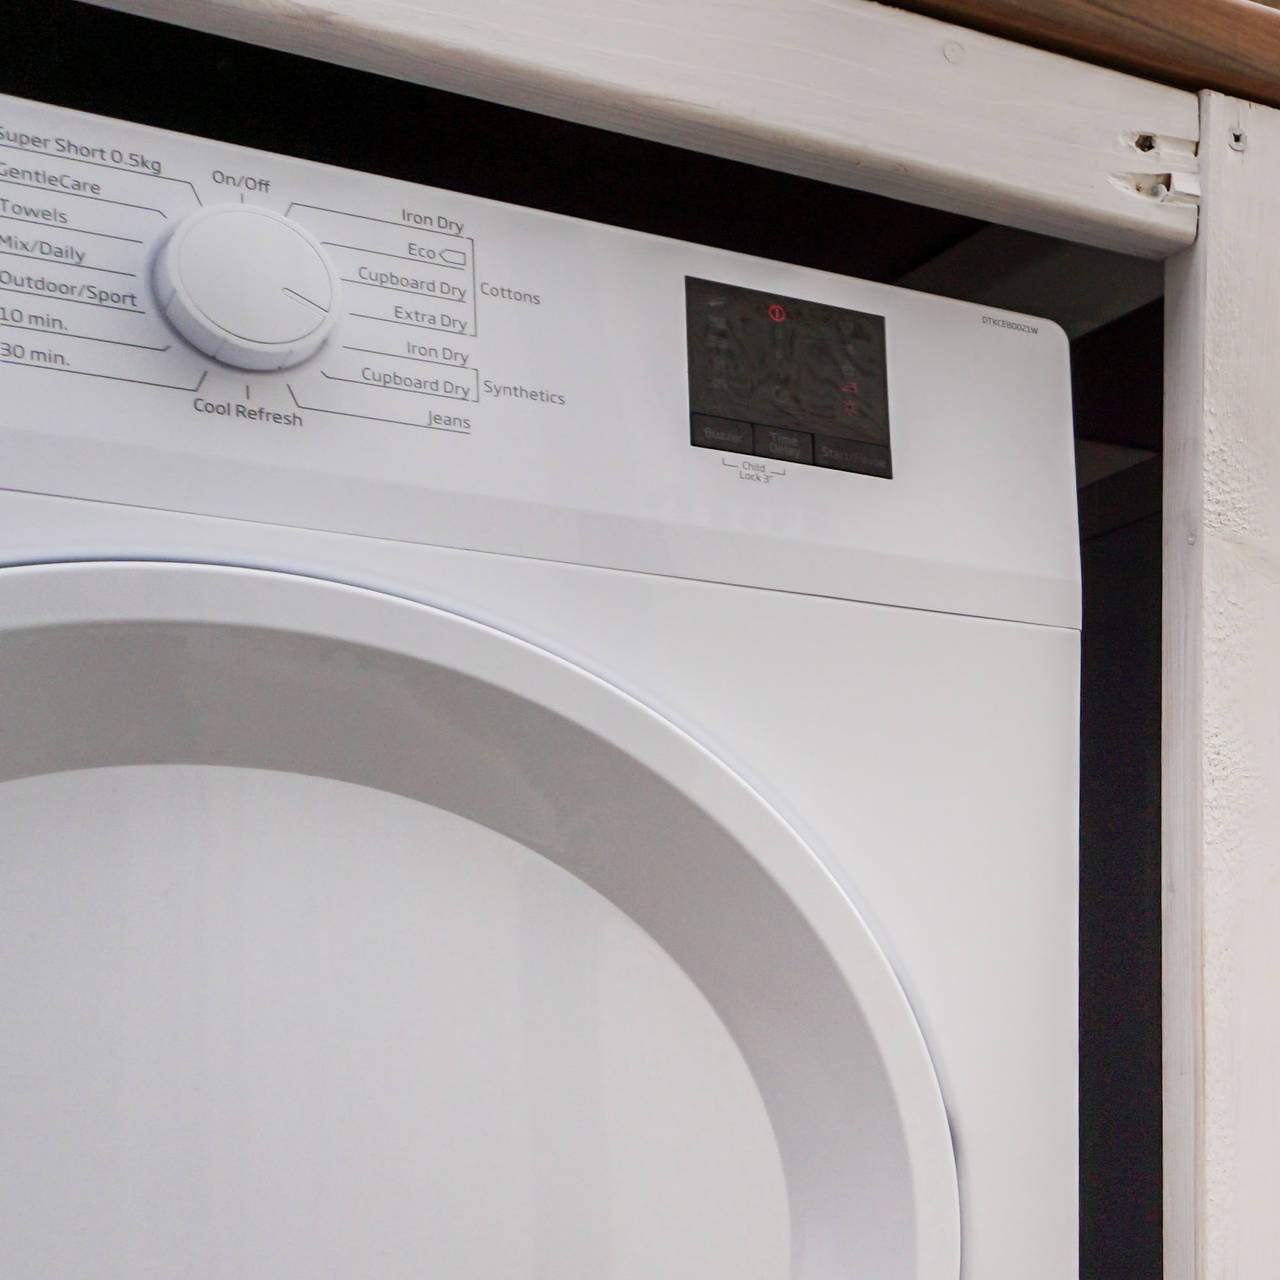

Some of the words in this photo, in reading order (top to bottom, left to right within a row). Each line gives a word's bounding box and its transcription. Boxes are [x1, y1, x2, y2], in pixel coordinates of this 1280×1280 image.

[0, 126, 50, 149] Super
[55, 138, 107, 161] Short
[110, 149, 162, 175] 0.5kg
[212, 170, 271, 193] On/Off
[0, 198, 68, 223] Towels
[402, 208, 433, 227] Iron
[437, 215, 464, 236] Dry
[0, 233, 86, 264] Mix/Daily
[408, 242, 436, 259] Eco
[0, 270, 138, 307] Outdoor/Sport
[358, 266, 436, 292] Cupboard
[440, 281, 467, 302] Dry
[480, 282, 542, 305] Cottons
[0, 306, 23, 323] 10
[28, 310, 68, 331] min.
[394, 305, 437, 325] Extra
[440, 313, 468, 334] Dry
[0, 342, 25, 359] 30
[30, 347, 70, 366] min.
[407, 341, 438, 359] Iron
[442, 347, 469, 366] Dry
[361, 367, 439, 392] Cupboard
[444, 380, 470, 400] Dry
[483, 379, 566, 405] Synthetics
[193, 397, 231, 416] Cool
[236, 404, 303, 427] Refresh
[427, 409, 471, 429] Jeans
[739, 471, 761, 482] Lock
[742, 460, 766, 473] Child
